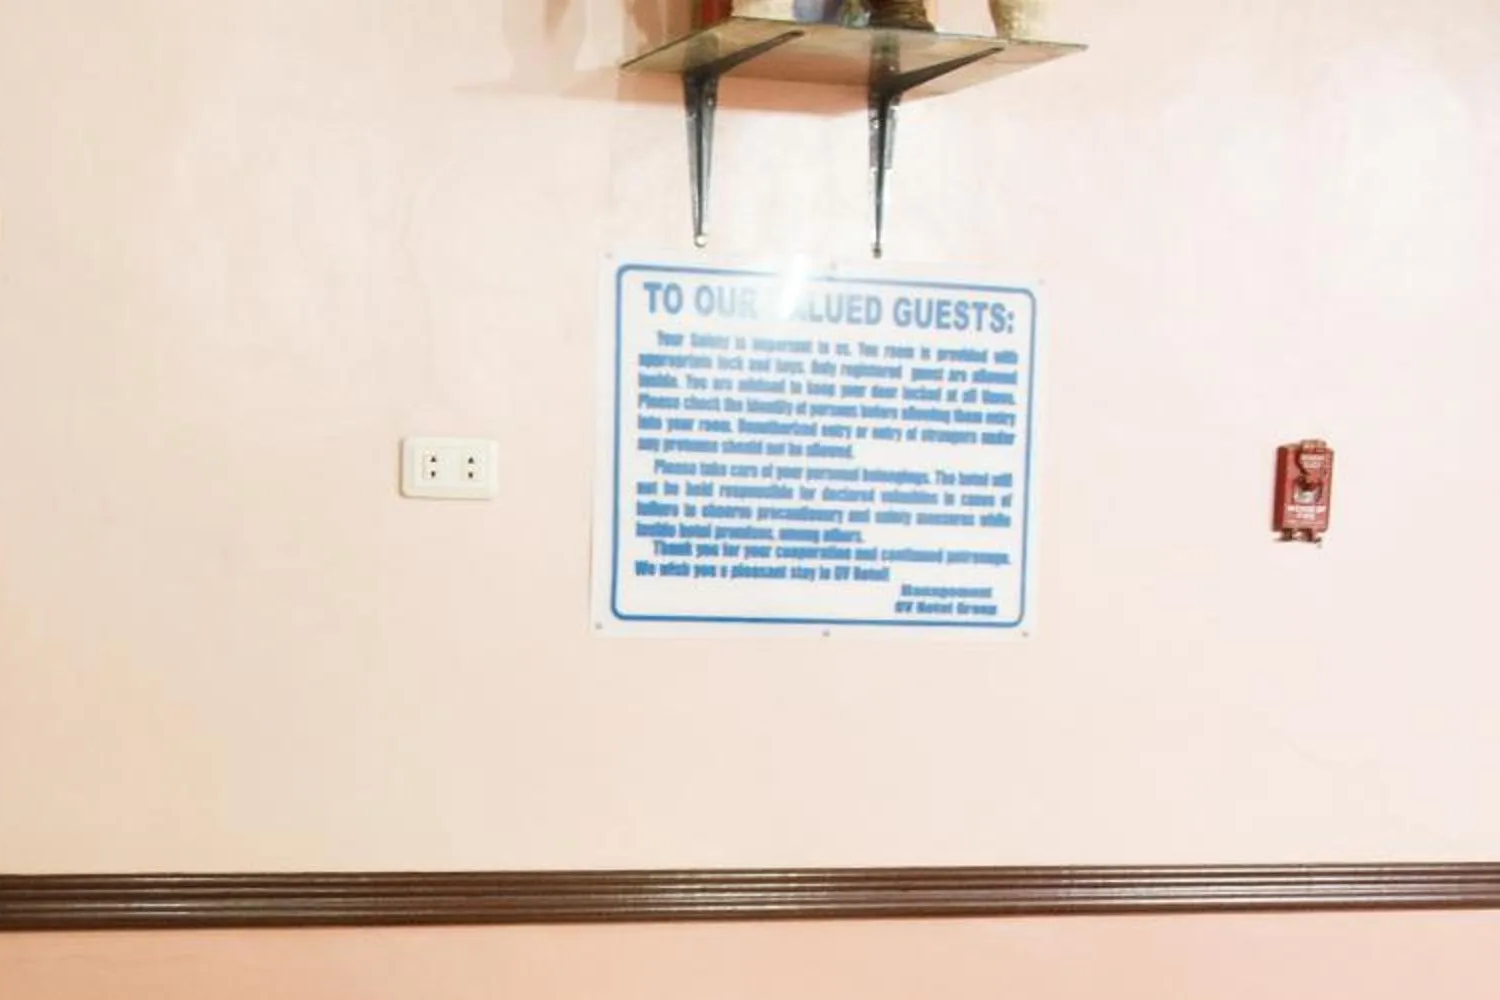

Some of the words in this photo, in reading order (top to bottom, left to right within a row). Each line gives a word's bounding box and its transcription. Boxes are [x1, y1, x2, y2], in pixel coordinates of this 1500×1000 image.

[643, 282, 683, 314] TO
[694, 285, 757, 319] OUR
[776, 288, 882, 326] ALUED
[893, 297, 1015, 335] GUESTS:
